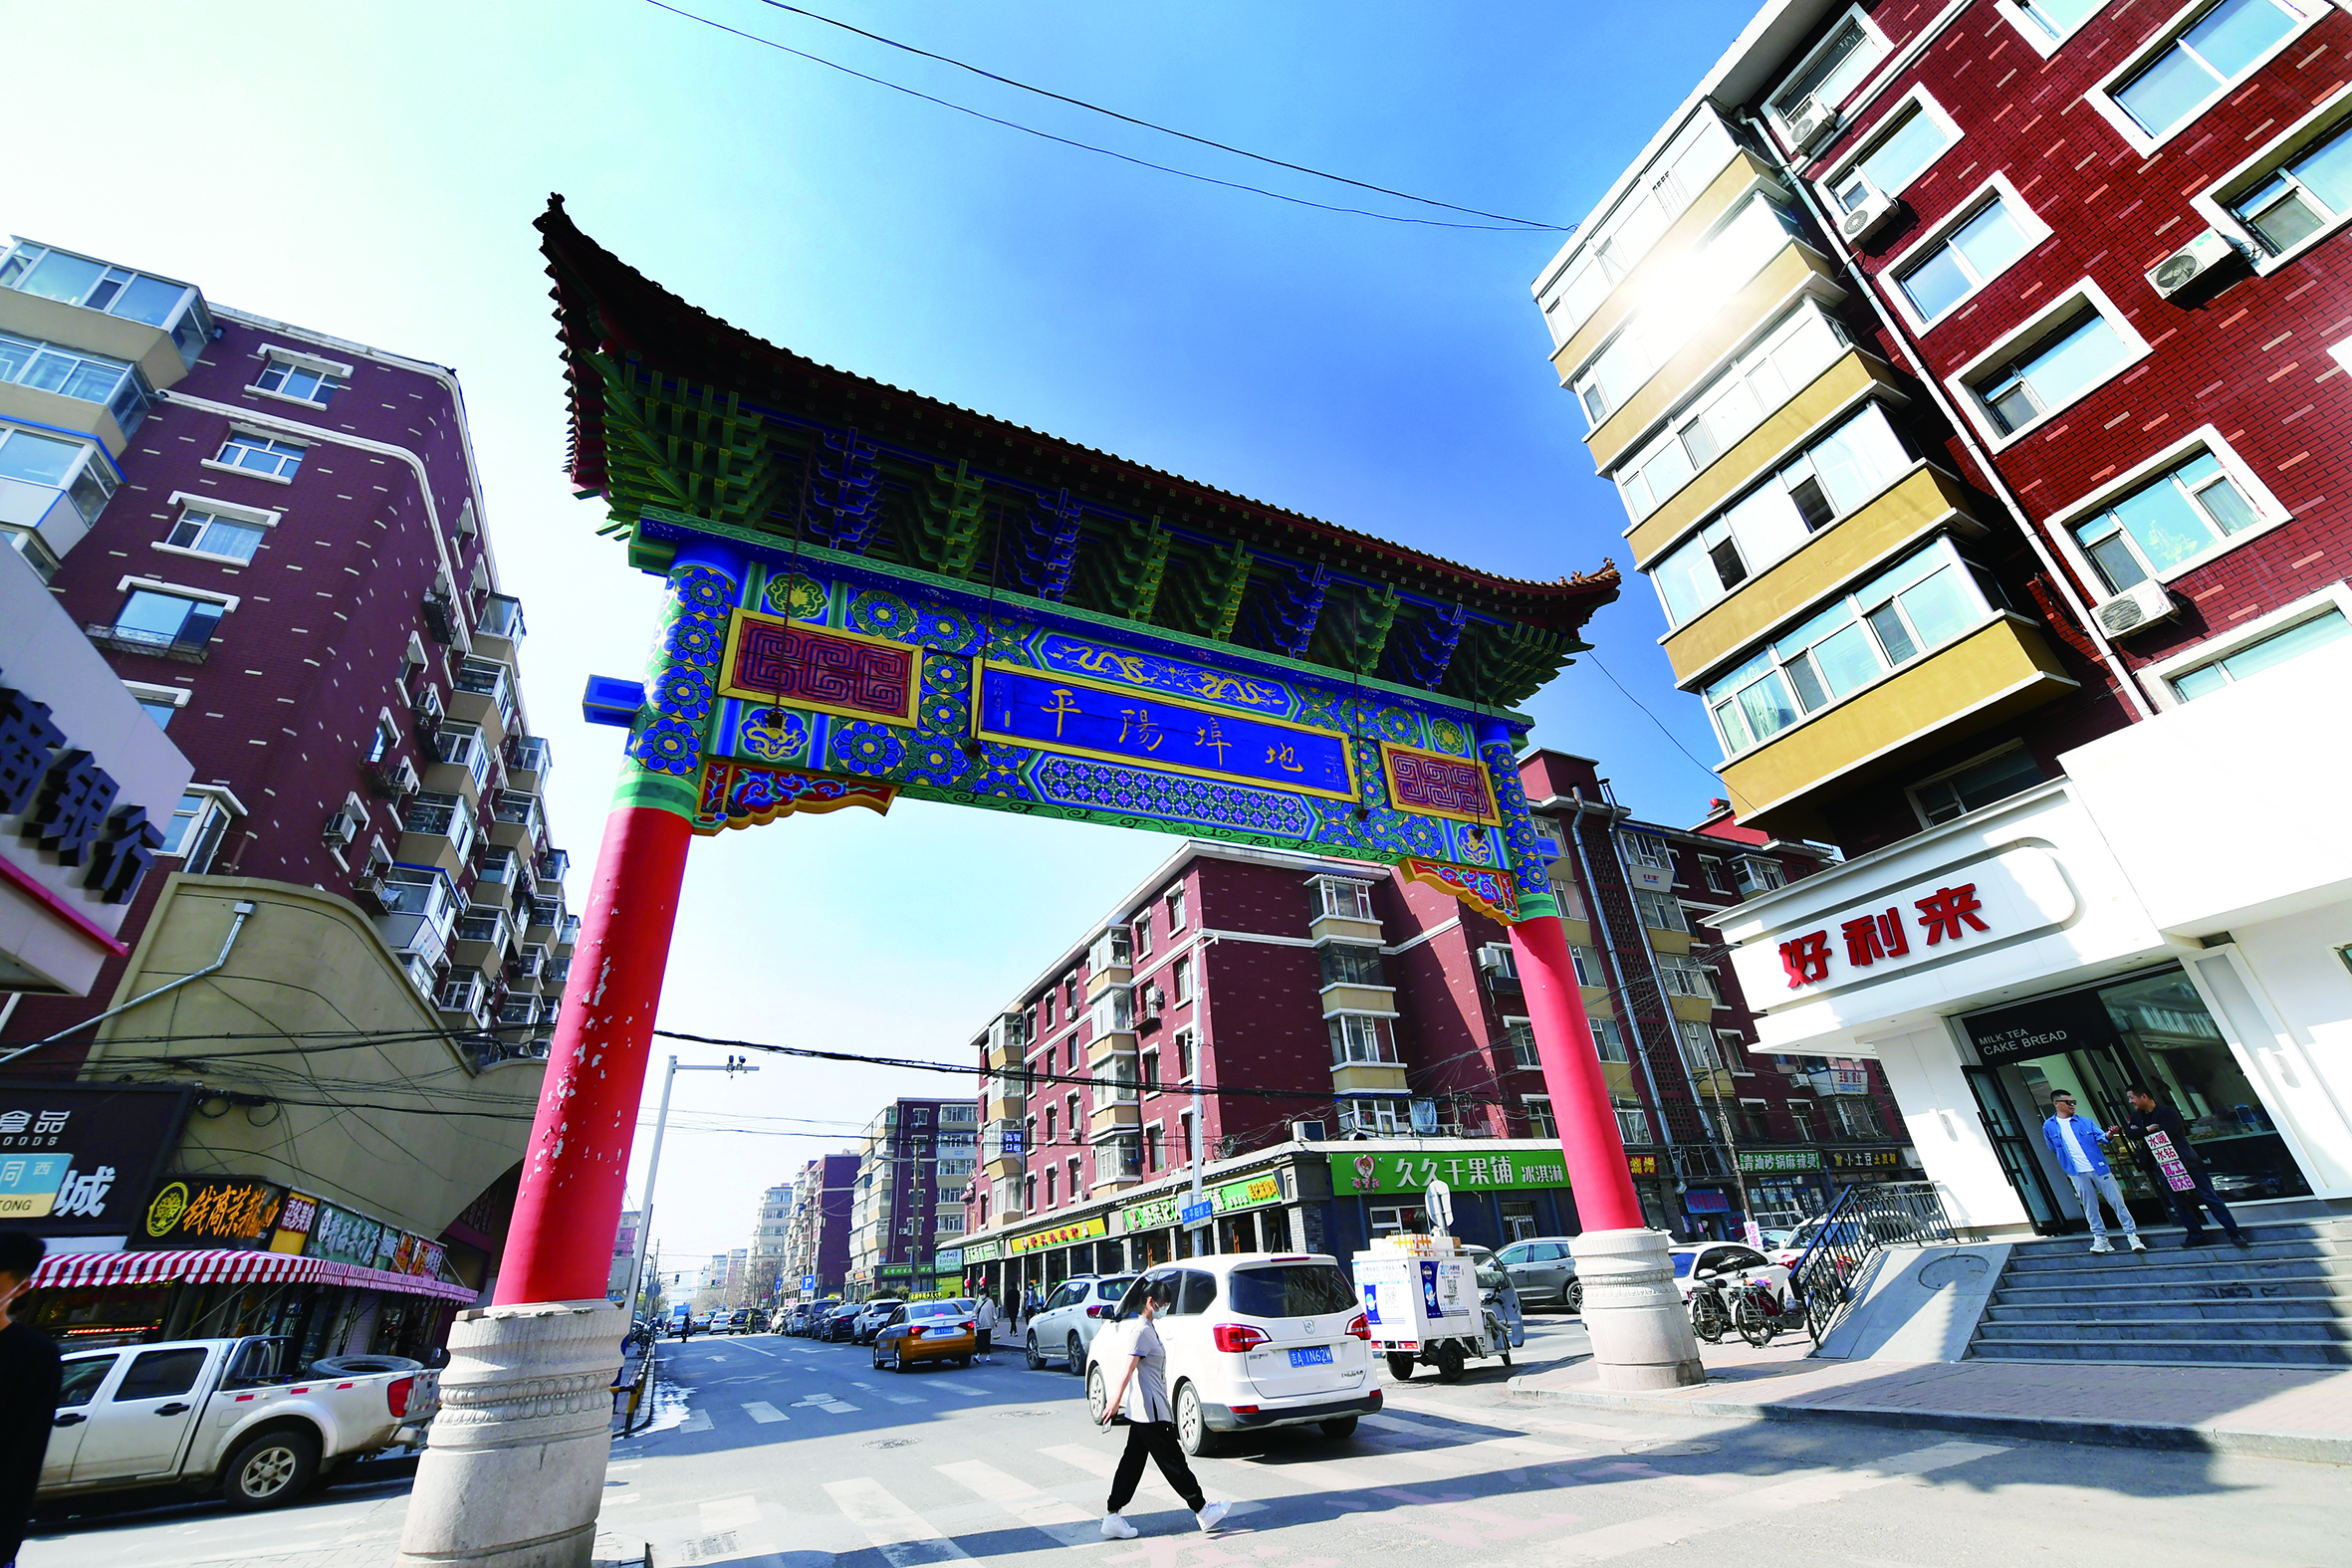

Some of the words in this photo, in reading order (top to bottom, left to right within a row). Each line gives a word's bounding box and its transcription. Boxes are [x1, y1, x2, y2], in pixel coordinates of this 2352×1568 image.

[1778, 883, 1991, 989] 好利来
[1979, 1032, 2004, 1045] MILK
[2005, 1027, 2029, 1039] TEA
[1984, 1040, 2018, 1055] CAKE
[2020, 1029, 2067, 1048] BREAD
[2148, 1133, 2170, 1147] 水暖
[2155, 1147, 2177, 1161] 水钻
[1395, 1156, 1514, 1188] 久久干果铺
[1521, 1164, 1564, 1184] 冰淇淋
[2161, 1161, 2186, 1176] 瓦工
[52, 1166, 117, 1218] 城
